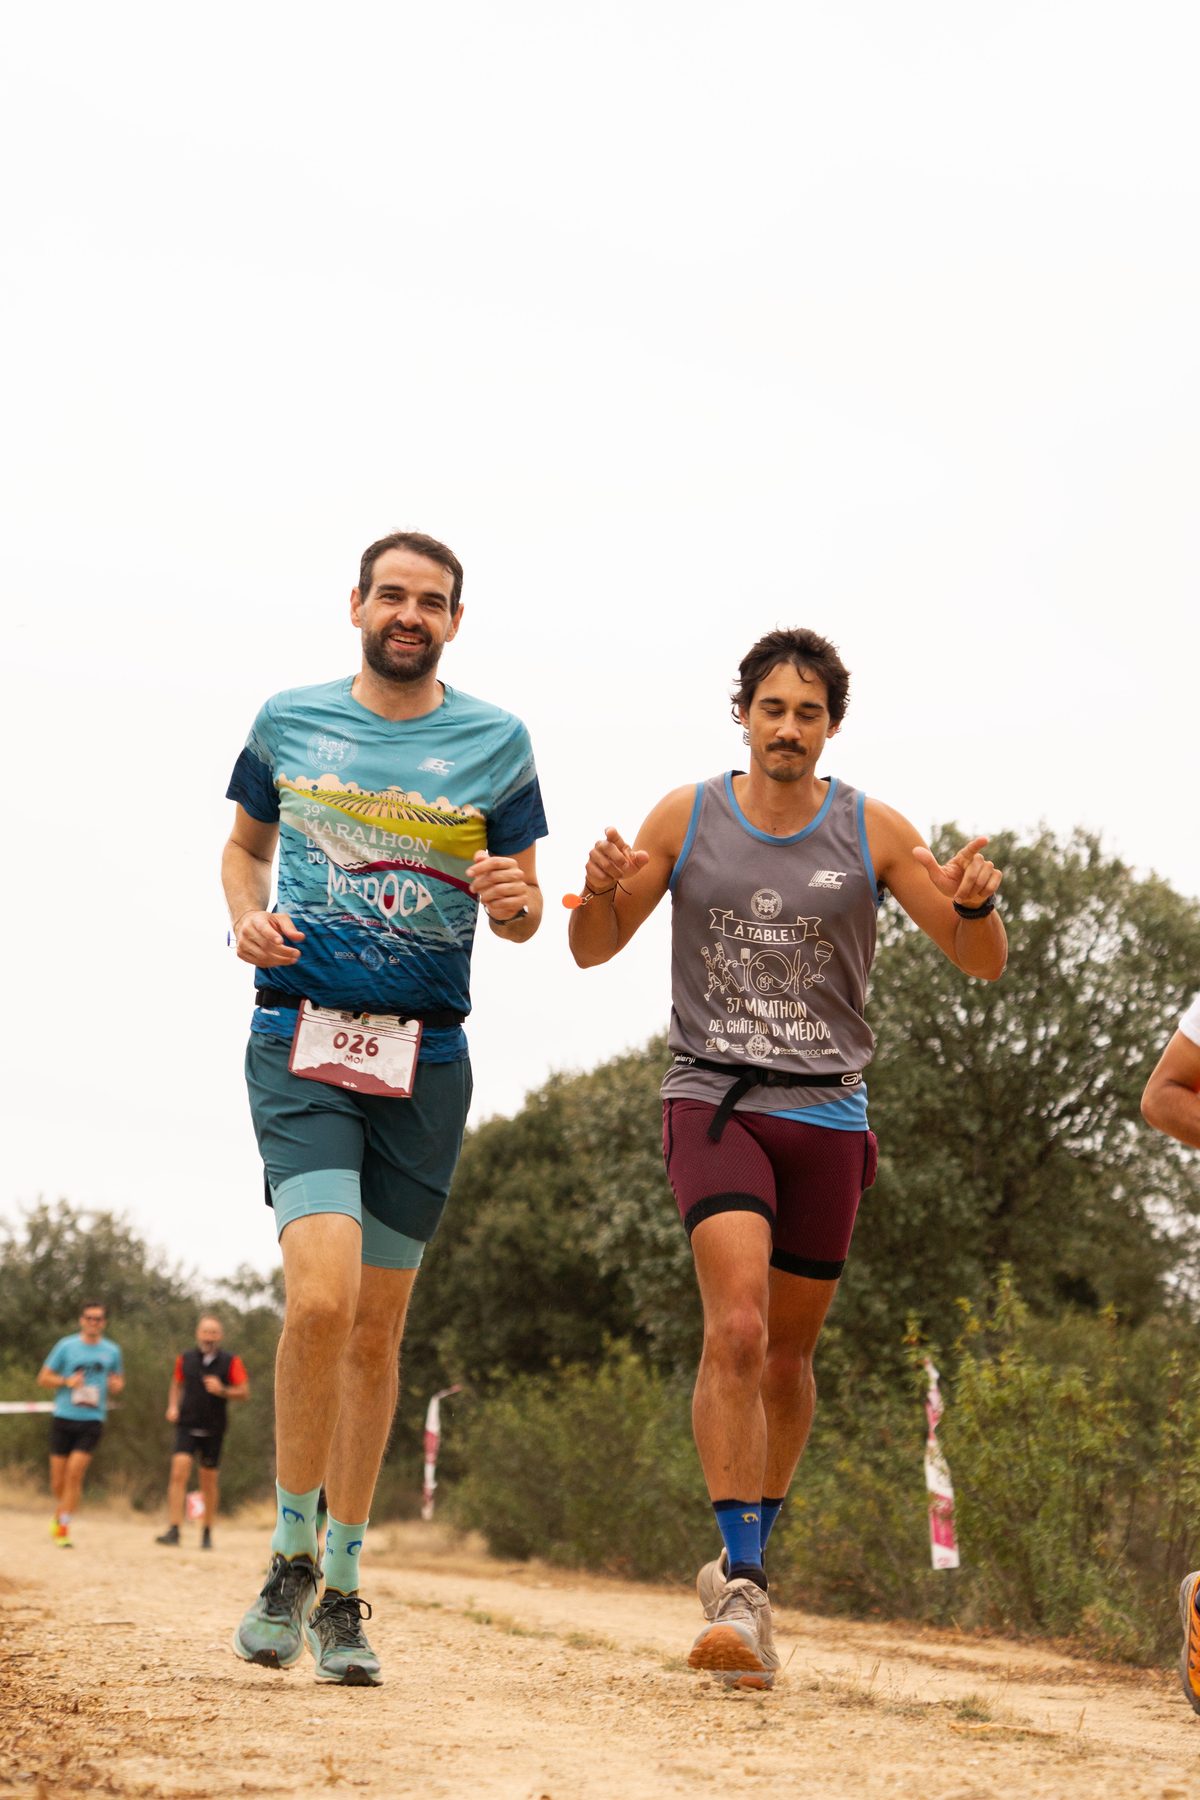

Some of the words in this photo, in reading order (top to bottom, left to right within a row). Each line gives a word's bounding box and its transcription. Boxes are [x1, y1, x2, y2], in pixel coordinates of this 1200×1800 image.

[303, 818, 434, 854] MARATHON
[307, 851, 328, 865] DU
[734, 922, 744, 937] À
[747, 927, 789, 942] TABLE
[745, 997, 807, 1019] MARATHON
[708, 1019, 724, 1034] DES
[727, 1017, 770, 1035] CHÂTEAUX
[785, 1018, 831, 1042] MÉDOC
[333, 1031, 379, 1057] 026
